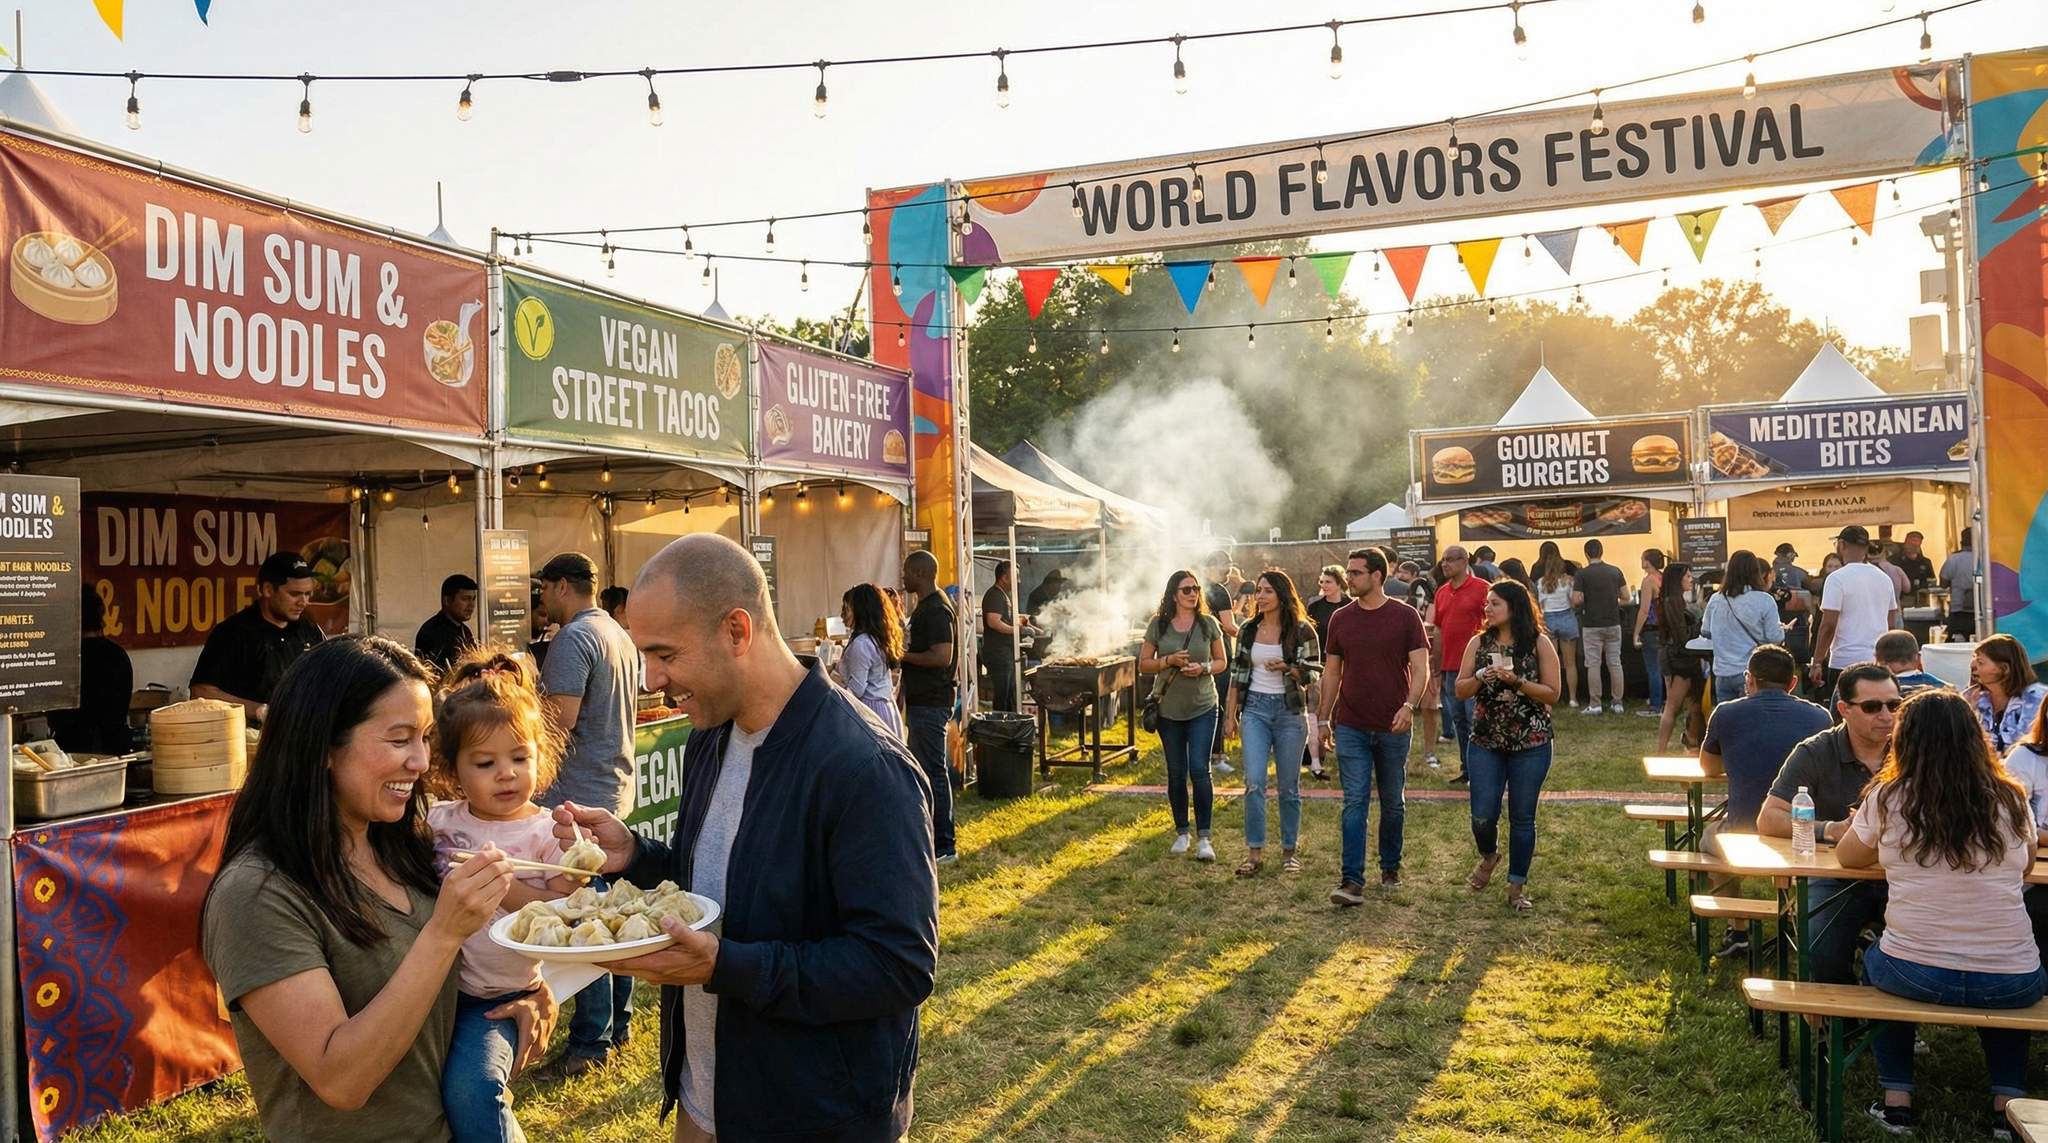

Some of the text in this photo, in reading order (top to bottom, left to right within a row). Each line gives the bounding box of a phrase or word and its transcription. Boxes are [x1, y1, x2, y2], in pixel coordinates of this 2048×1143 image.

[1078, 103, 1824, 236] WORLD FLAVORS FESTIVAL
[145, 202, 408, 328] DIM SUM &
[175, 299, 386, 398] NOODLES
[600, 315, 679, 379] VEGAN
[552, 366, 721, 441] STREET TACOS
[786, 361, 892, 421] GLUTEN-FREE
[812, 414, 871, 460] BAKERY
[1497, 430, 1610, 461] GOURMET
[1750, 404, 1964, 442] MEDITERRANEAN
[1820, 438, 1892, 467] BITES
[1502, 458, 1610, 488] BURGERS
[0, 517, 53, 539] ODLES
[11, 493, 46, 515] SUM
[52, 495, 65, 516] &
[97, 506, 278, 567] DIM SUM
[96, 578, 123, 636] &
[636, 745, 686, 808] EGA
